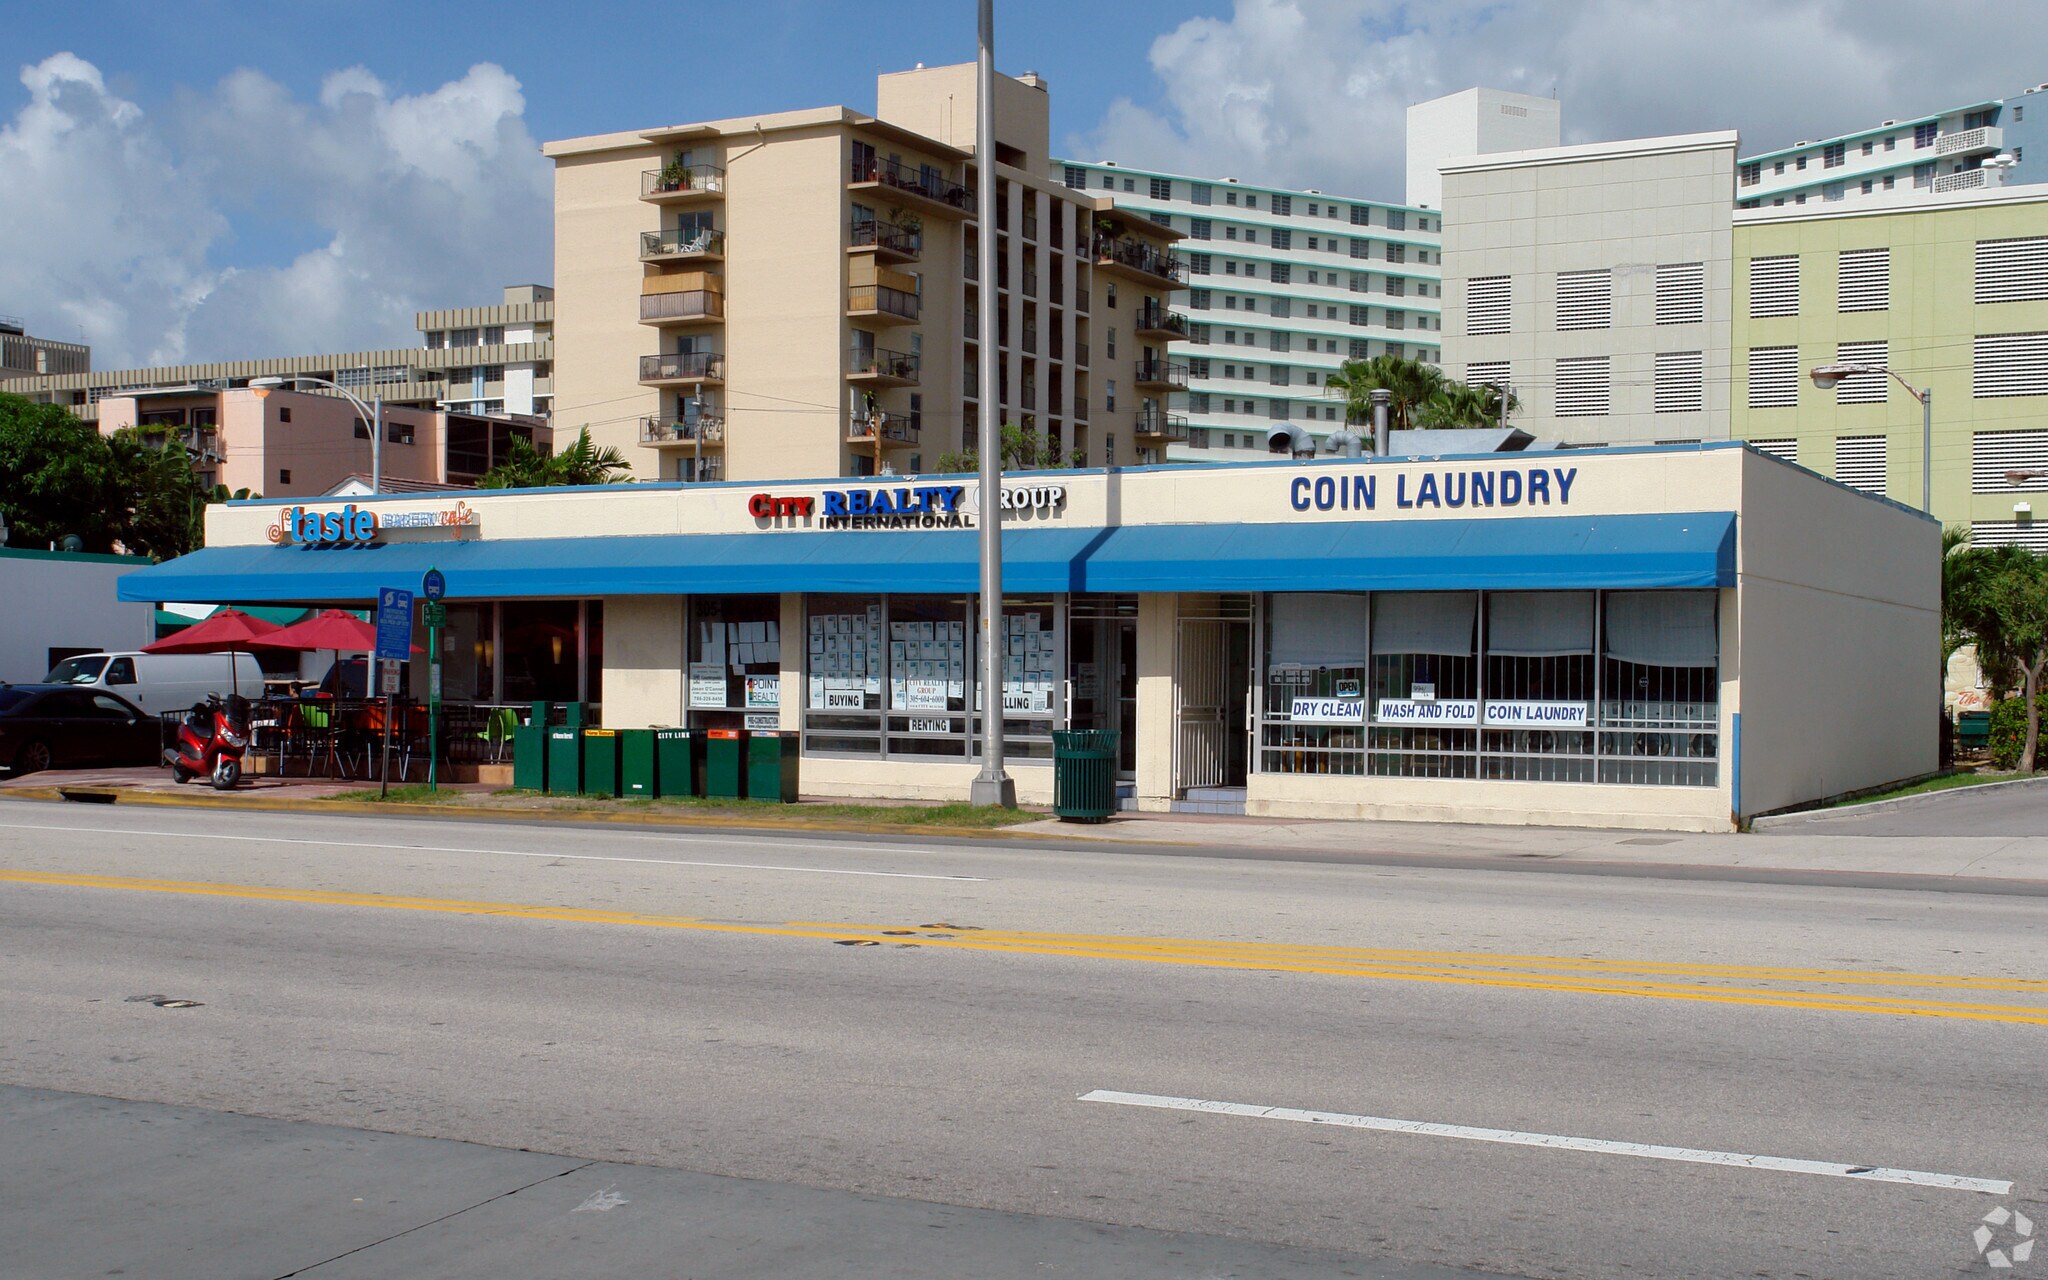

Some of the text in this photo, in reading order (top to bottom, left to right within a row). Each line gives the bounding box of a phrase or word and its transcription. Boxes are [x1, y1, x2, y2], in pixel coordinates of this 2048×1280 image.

[1291, 467, 1578, 511] COIN LAUNDRY
[748, 493, 813, 518] CITY
[822, 486, 963, 515] REALTY
[290, 504, 378, 542] taste
[819, 514, 975, 530] INTERNATIONAL
[753, 679, 779, 690] POINT
[1339, 681, 1358, 692] OPEN
[753, 692, 779, 701] REALTY
[829, 694, 860, 707] BUYING
[1002, 696, 1030, 709] LLING
[1293, 702, 1362, 717] DRY CLEAN
[1382, 703, 1475, 719] WASH AND FOLD
[1488, 704, 1585, 721] COIN LAUNDRY
[911, 719, 947, 731] RENTING
[674, 731, 690, 739] LINK
